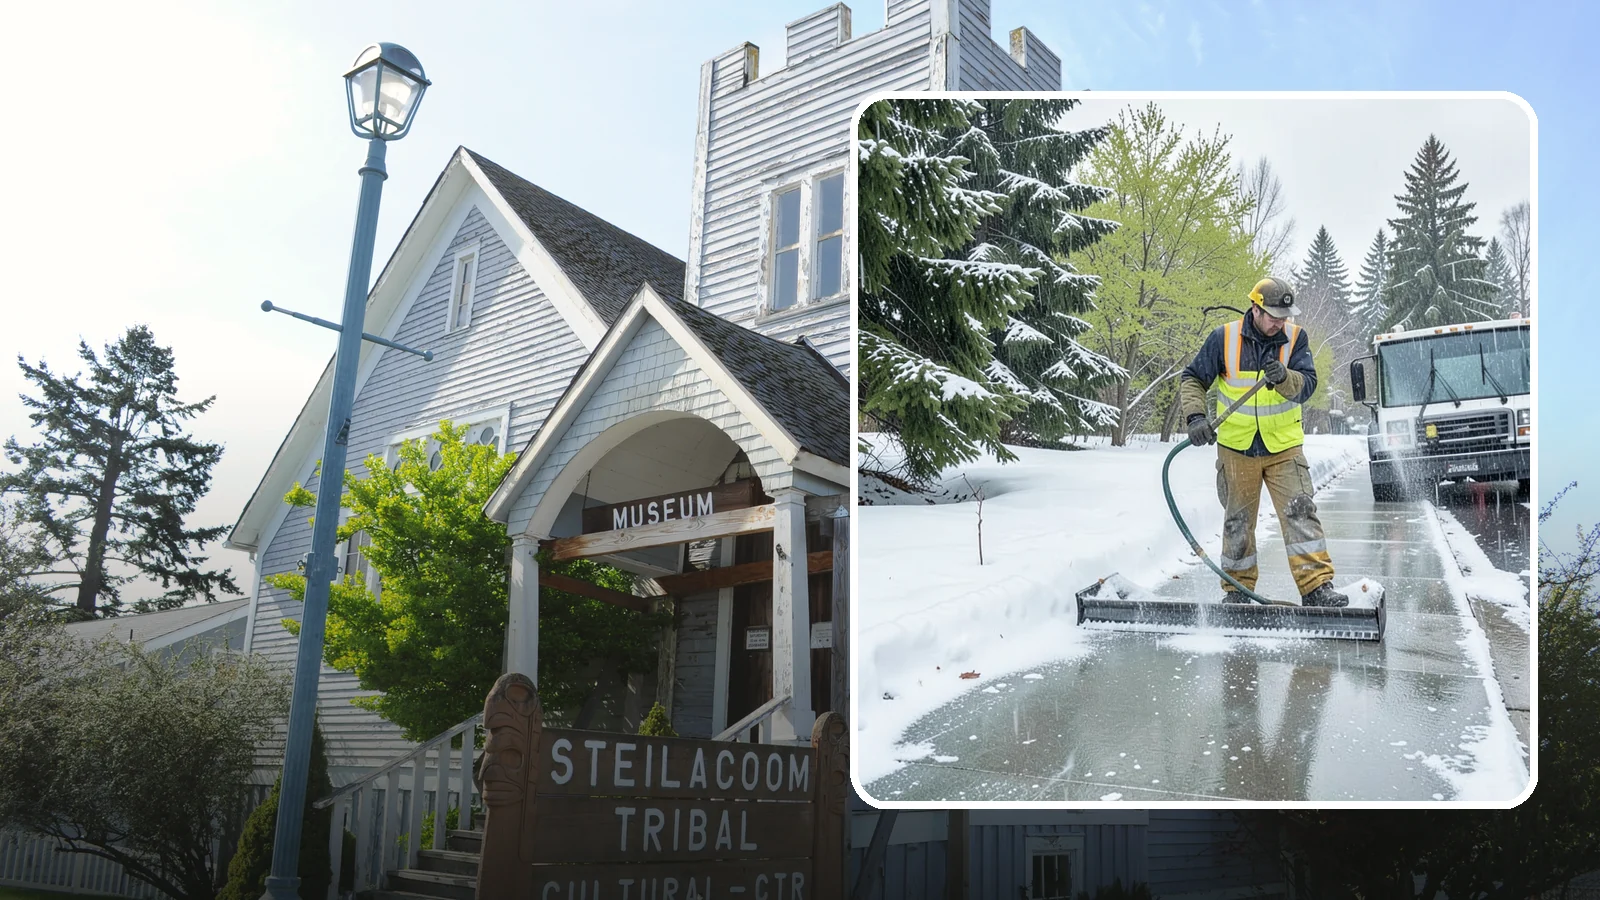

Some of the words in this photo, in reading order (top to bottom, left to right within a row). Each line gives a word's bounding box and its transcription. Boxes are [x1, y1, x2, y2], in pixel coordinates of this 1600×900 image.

[613, 491, 714, 531] MUSEUM
[550, 738, 810, 793] STEILACOOM
[615, 806, 758, 852] TRIBAL
